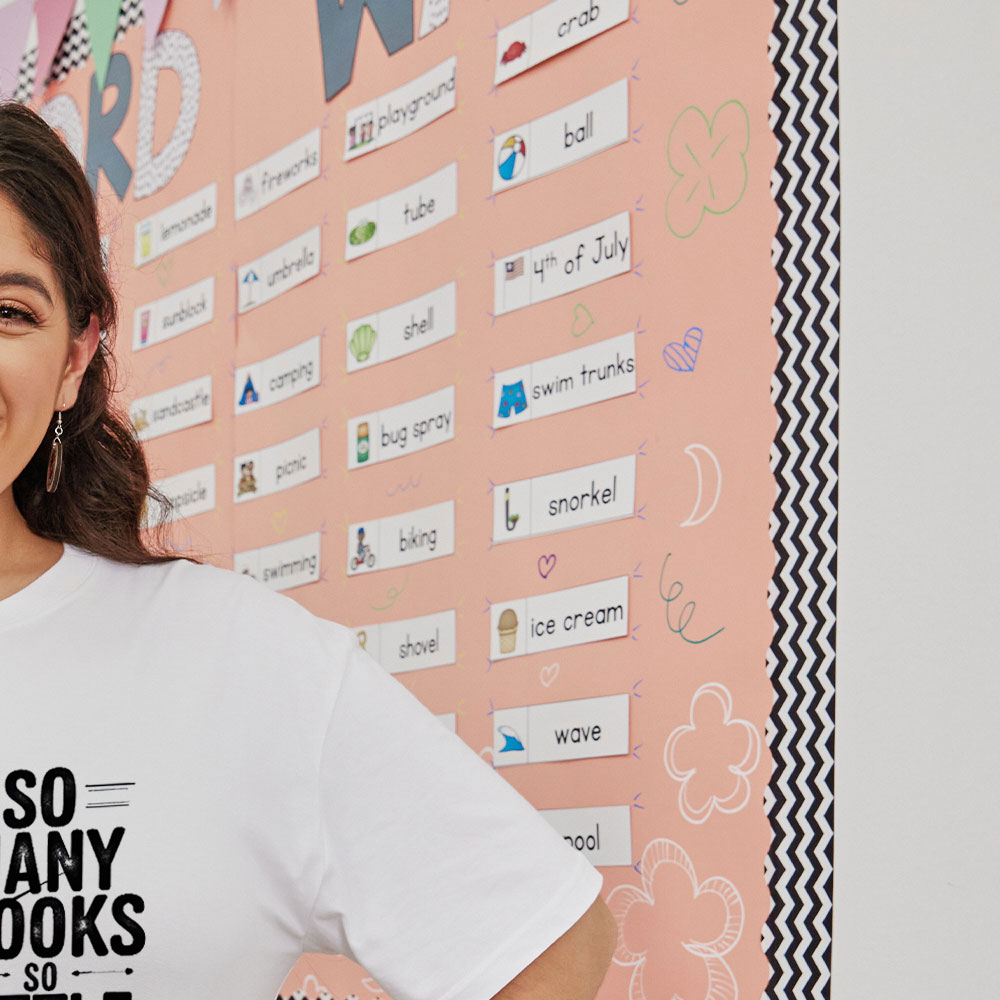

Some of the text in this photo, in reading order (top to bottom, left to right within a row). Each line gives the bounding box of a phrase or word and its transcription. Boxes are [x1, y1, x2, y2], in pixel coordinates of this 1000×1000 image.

[557, 0, 599, 38] crab
[377, 66, 456, 135] playground
[564, 111, 593, 149] ball
[261, 148, 318, 193] fireworks
[161, 200, 212, 240] lemonade
[403, 195, 435, 225] tube
[267, 246, 315, 287] umbrella
[533, 230, 628, 283] 4th of July
[162, 293, 208, 329] sunblock
[403, 306, 434, 340] shell
[269, 361, 314, 392] camping
[532, 352, 635, 400] swim trunks
[152, 387, 210, 422] sandcastle
[381, 411, 452, 449] bug spray
[275, 455, 307, 485] picnic
[548, 475, 616, 516] snorkel
[399, 526, 437, 552] biking
[263, 555, 317, 582] swimming
[531, 604, 624, 638] ice cream
[398, 628, 440, 659] shovel
[555, 725, 602, 745] wave
[2, 767, 77, 829] SO
[22, 962, 58, 992] SO
